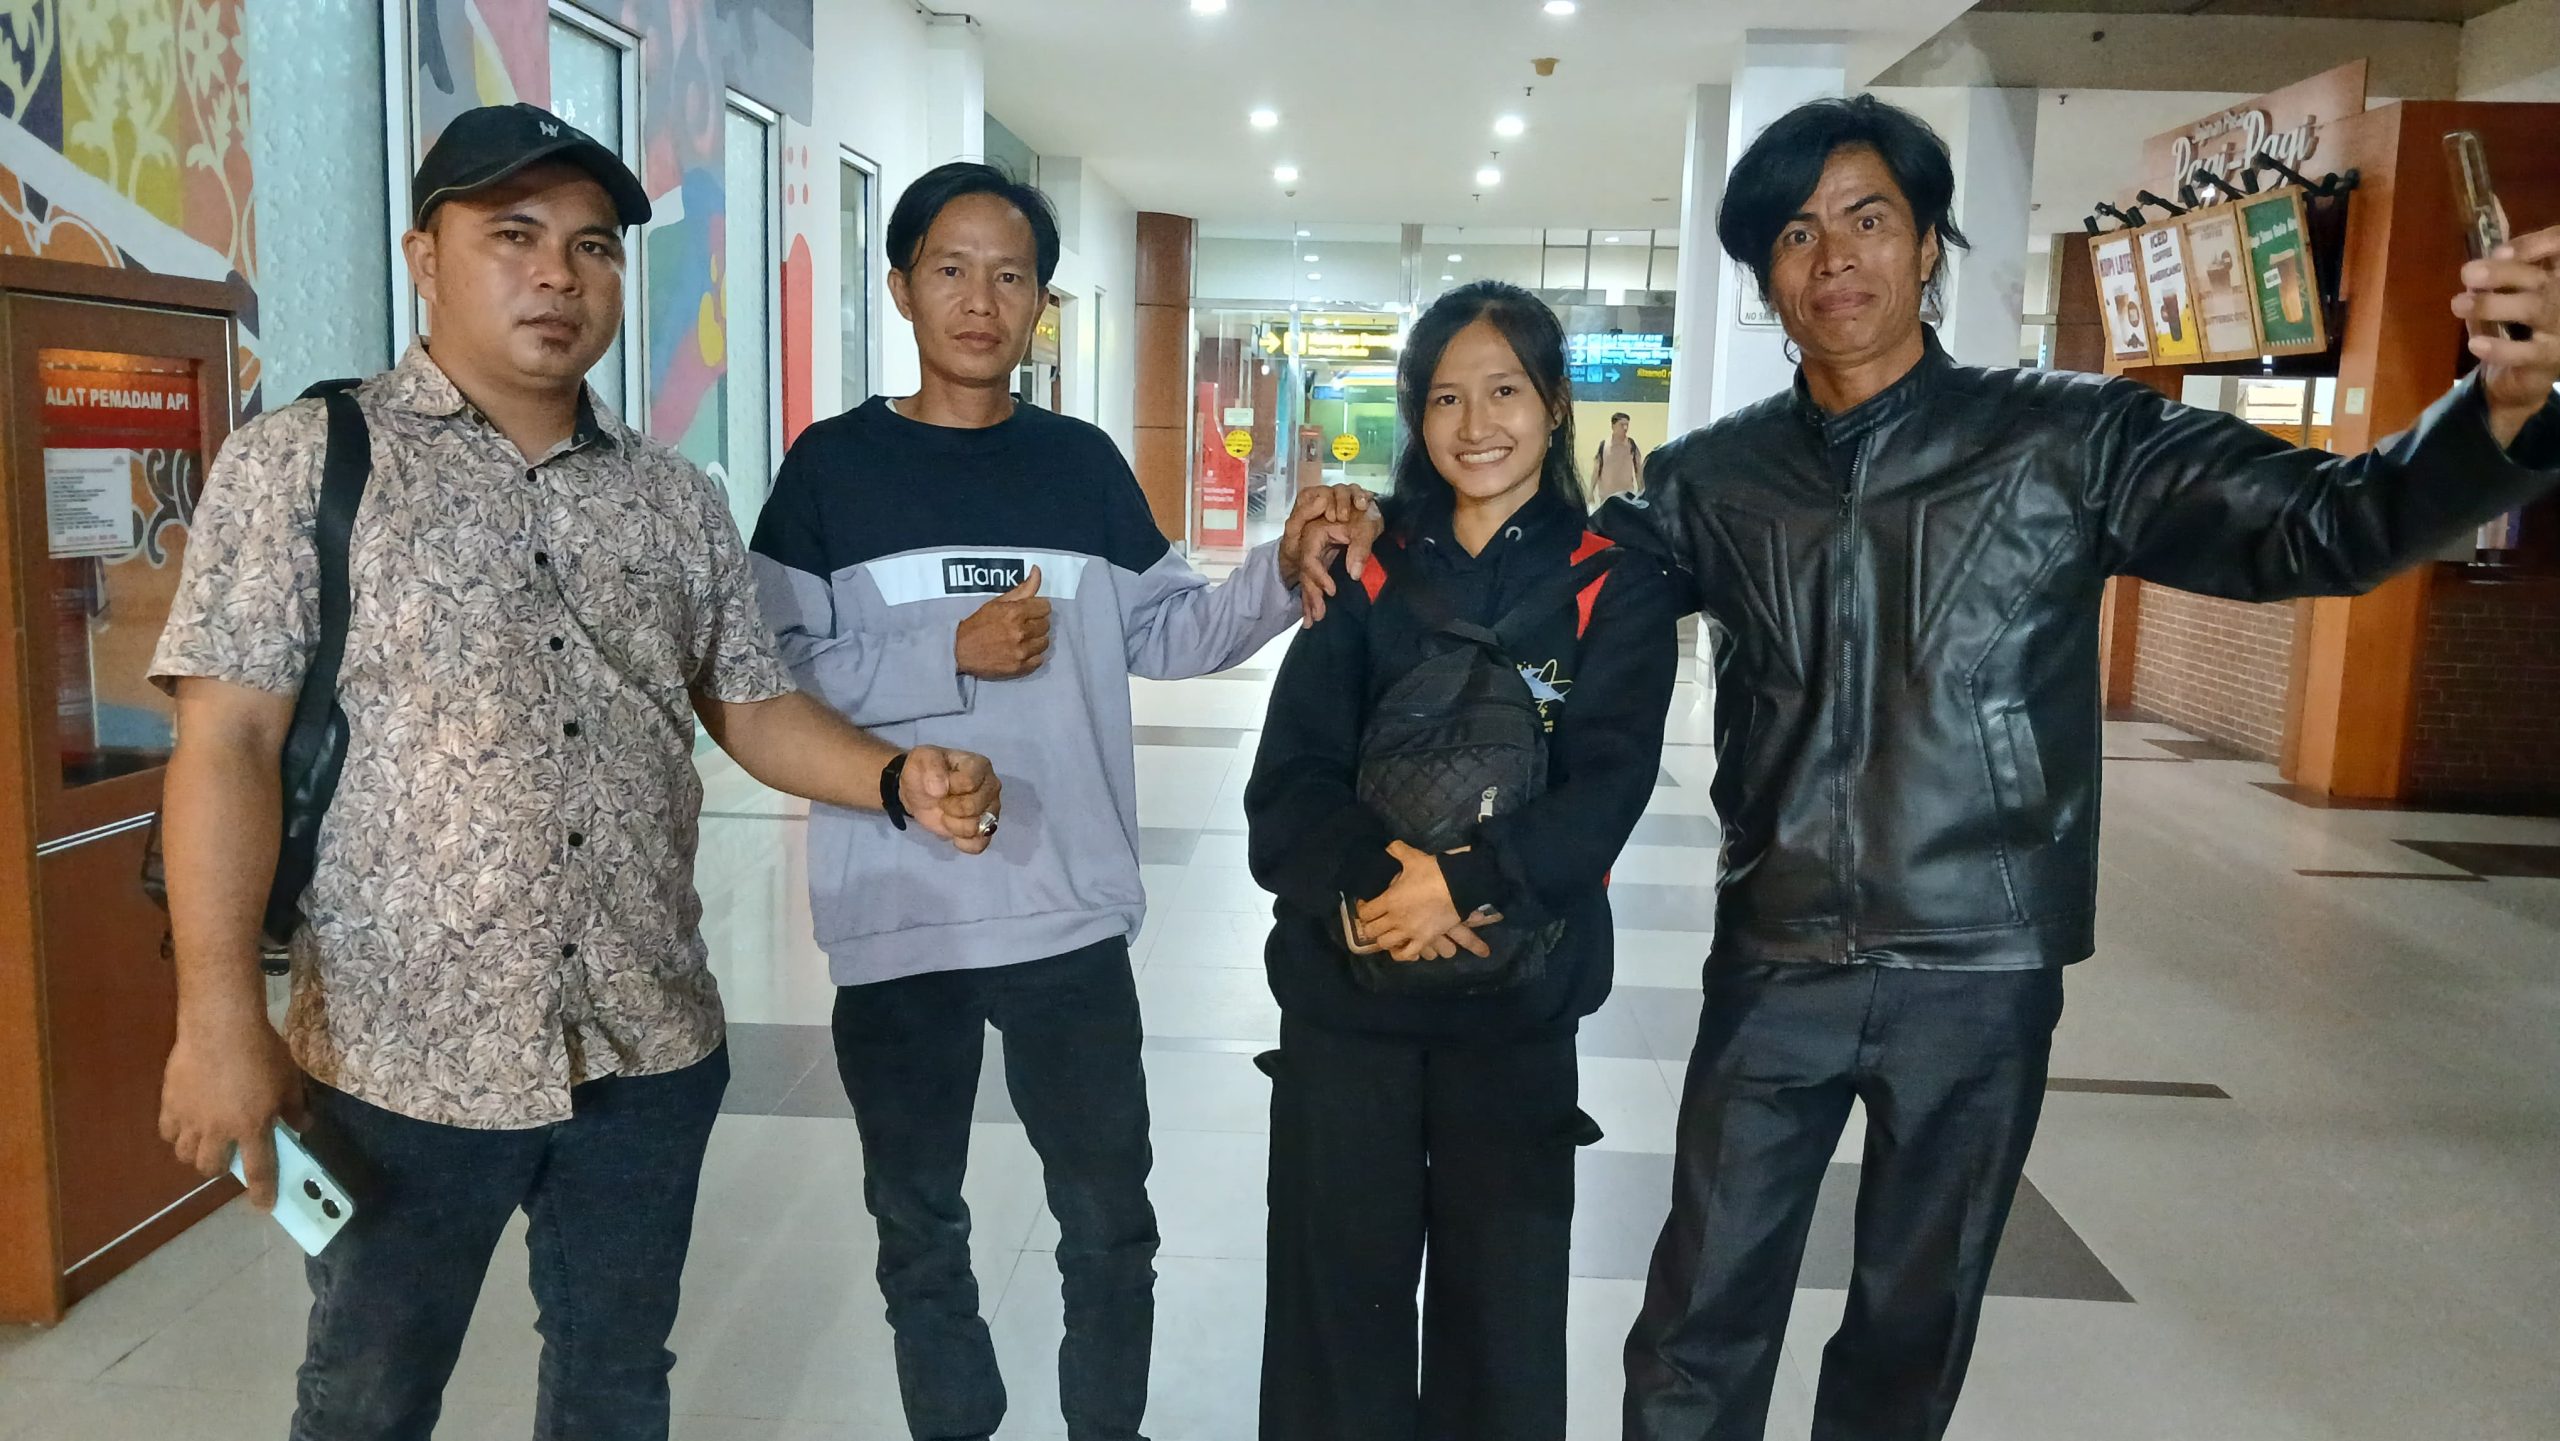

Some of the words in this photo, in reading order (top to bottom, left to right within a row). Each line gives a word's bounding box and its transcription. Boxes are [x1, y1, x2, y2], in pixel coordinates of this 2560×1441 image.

[2150, 230, 2168, 248] ICED
[1744, 311, 1757, 320] NO
[45, 386, 86, 406] ALAT
[89, 388, 163, 409] PEMADAM
[166, 392, 189, 411] API
